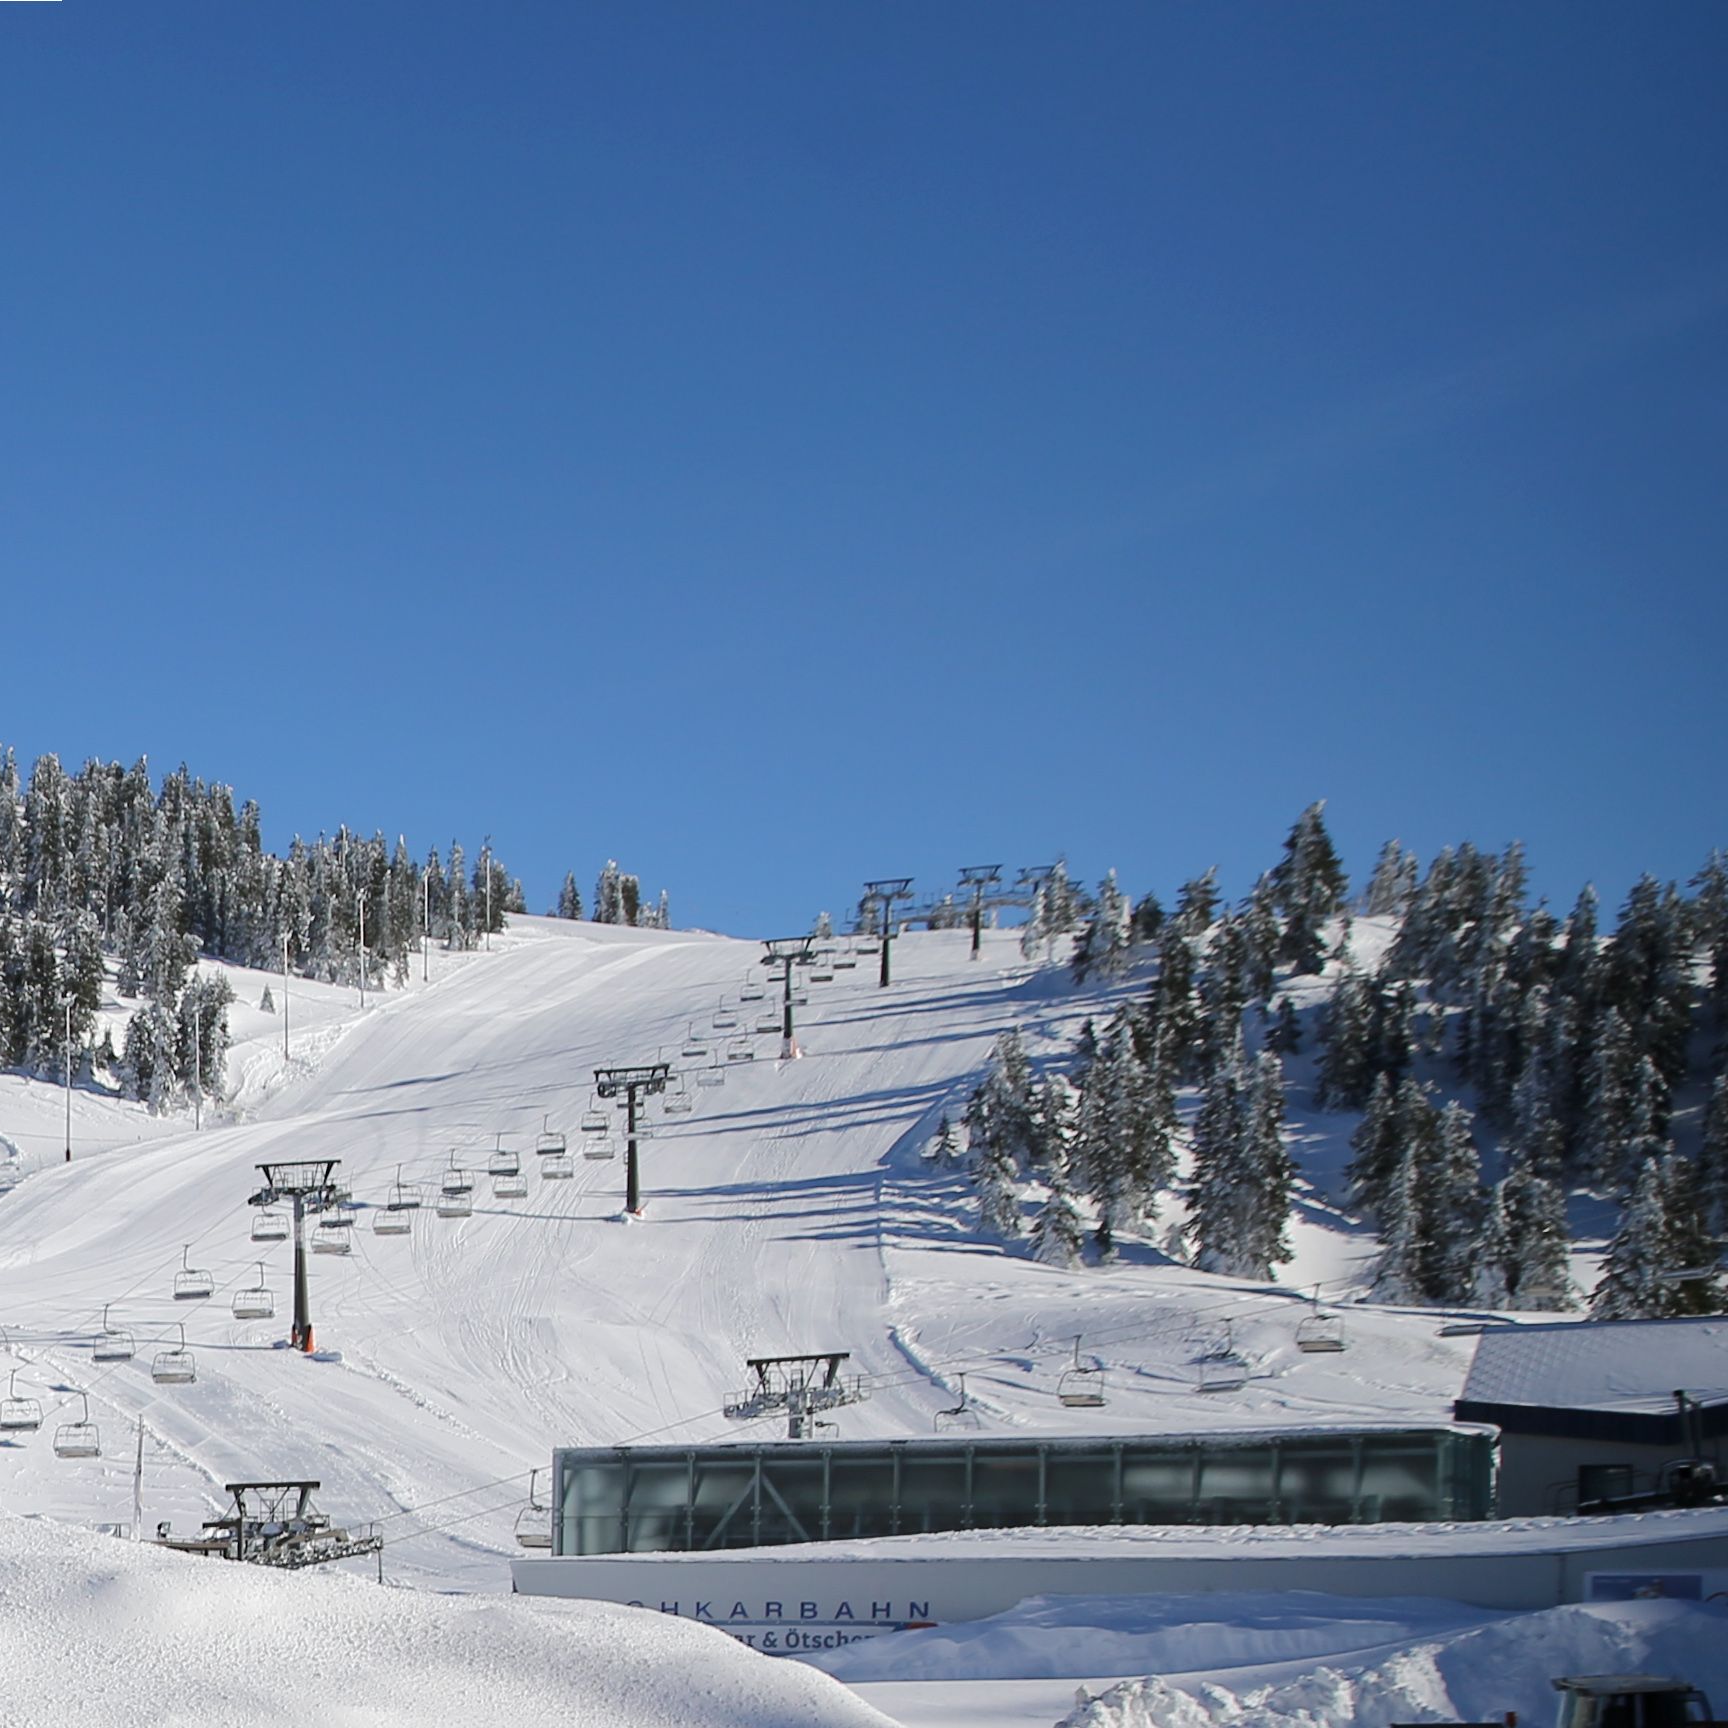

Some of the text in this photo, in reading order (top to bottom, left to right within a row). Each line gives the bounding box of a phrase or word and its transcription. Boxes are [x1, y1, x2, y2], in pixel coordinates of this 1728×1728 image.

[627, 1600, 930, 1619] HKARBAHN
[762, 1631, 778, 1648] &
[785, 1628, 874, 1648] Ötsch
